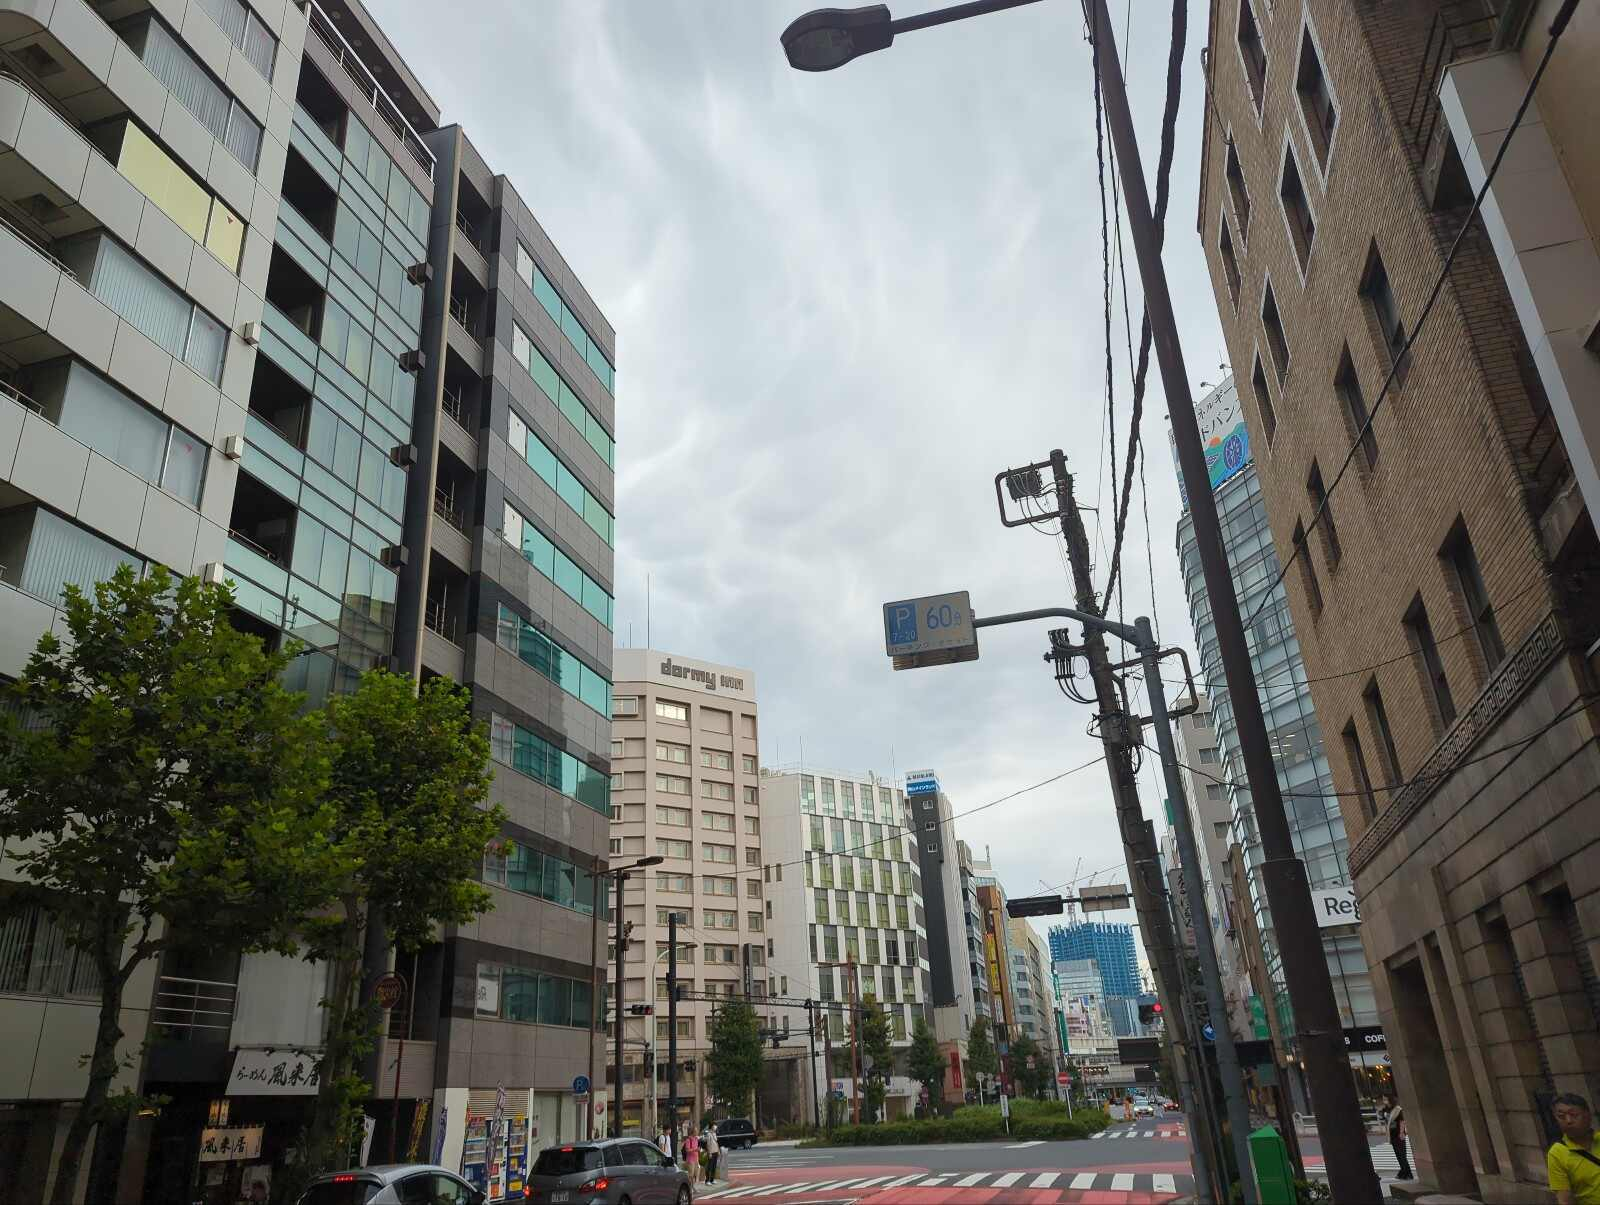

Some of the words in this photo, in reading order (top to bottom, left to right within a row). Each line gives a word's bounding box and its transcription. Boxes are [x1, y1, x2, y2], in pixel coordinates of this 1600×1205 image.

[895, 607, 910, 632] P
[661, 658, 716, 690] dormy
[720, 674, 744, 691] inn
